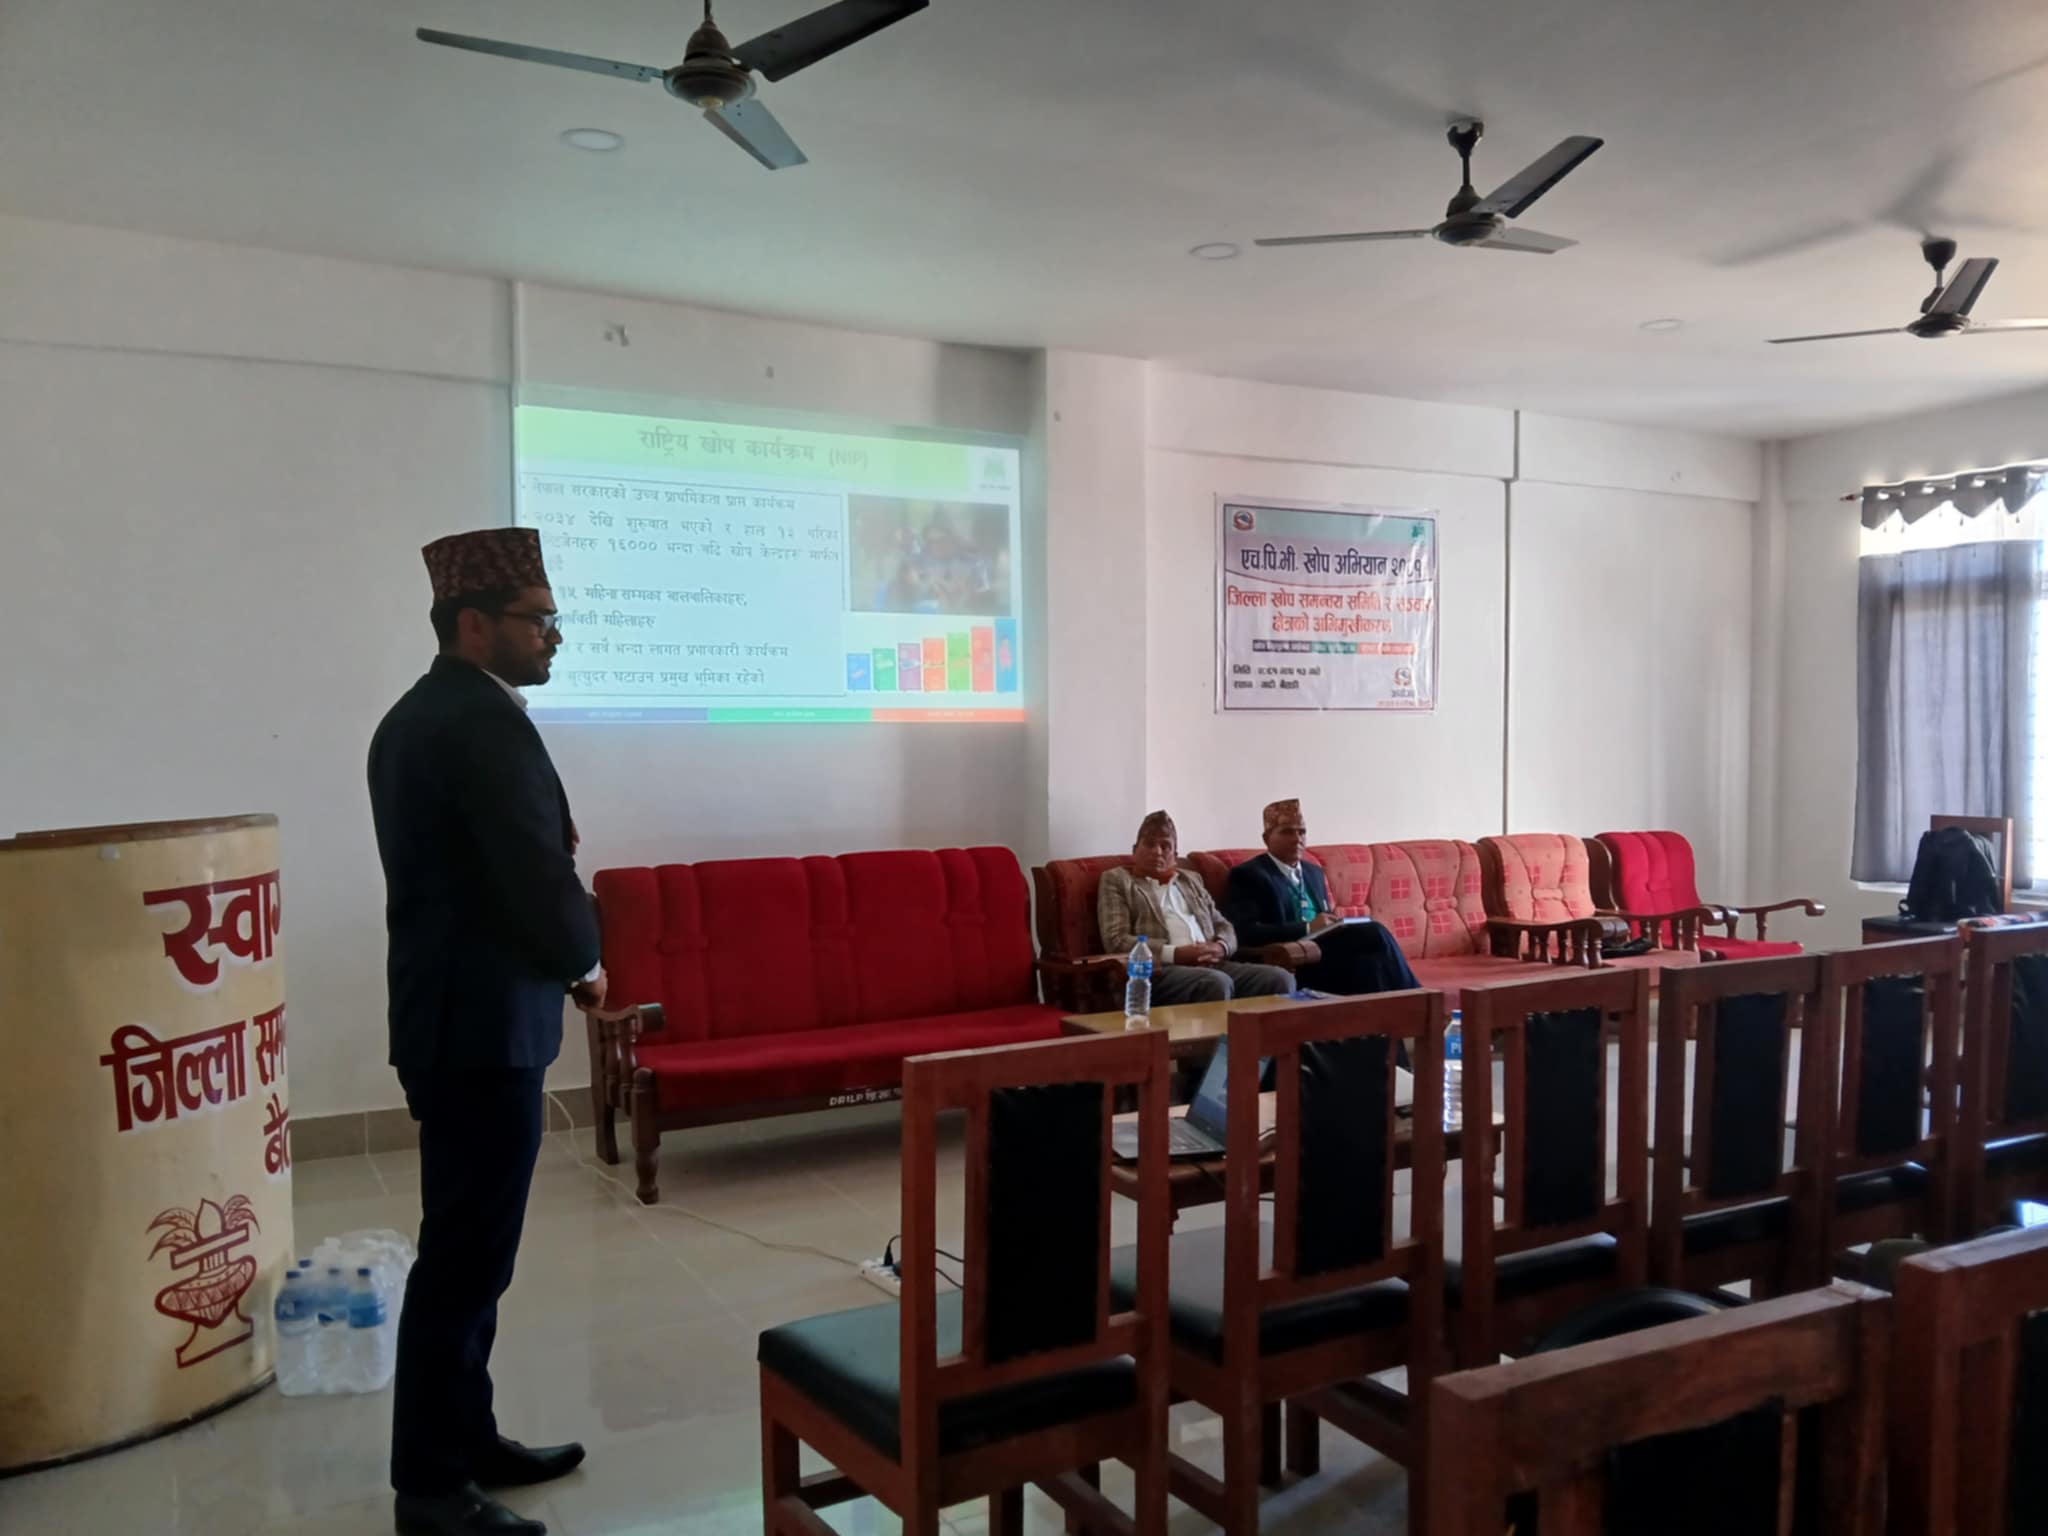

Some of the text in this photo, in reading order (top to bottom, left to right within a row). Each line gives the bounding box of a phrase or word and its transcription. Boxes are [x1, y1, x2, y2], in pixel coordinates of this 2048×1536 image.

[638, 425, 689, 457] राष्ट्रिय
[697, 430, 737, 455] खोप
[744, 435, 816, 461] कार्यक्रम
[608, 537, 658, 552] १६०००
[1302, 546, 1331, 574] खोप
[1334, 547, 1388, 576] अभियान
[1271, 587, 1296, 608] खोप
[100, 1020, 247, 1132] जिल्ला
